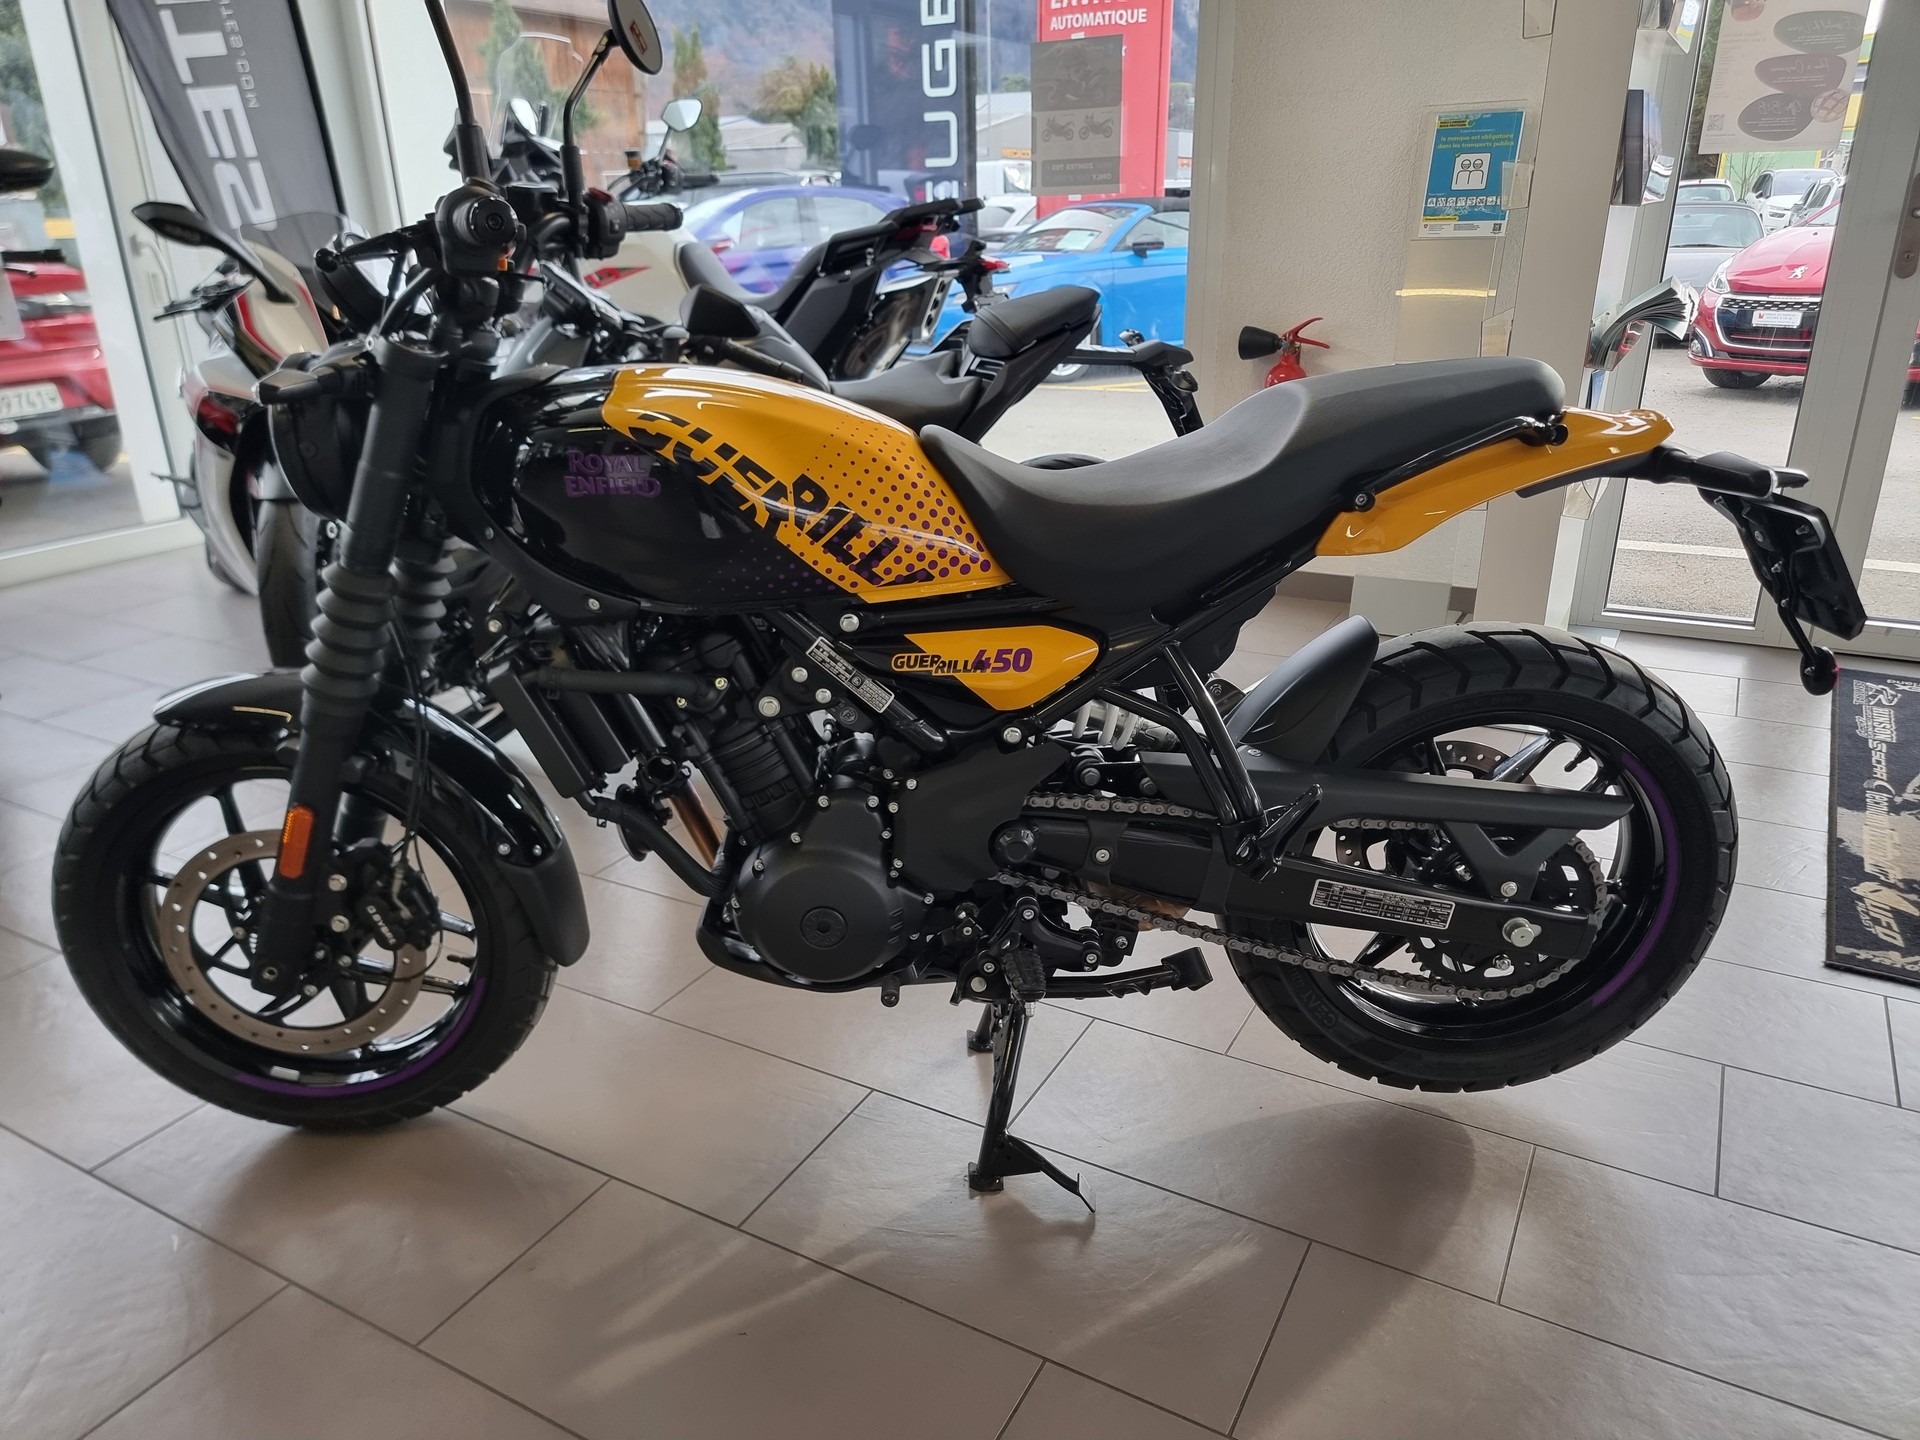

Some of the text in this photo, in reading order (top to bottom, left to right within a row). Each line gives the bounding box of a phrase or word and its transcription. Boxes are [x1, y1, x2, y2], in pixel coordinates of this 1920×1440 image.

[1050, 8, 1147, 31] AUTOMATIQUE
[1481, 133, 1514, 141] obligatoire
[565, 450, 647, 474] ROYAL
[564, 475, 661, 498] ENFIELD
[893, 647, 1033, 674] GUERRILLA 450
[1872, 707, 1893, 740] HINSON
